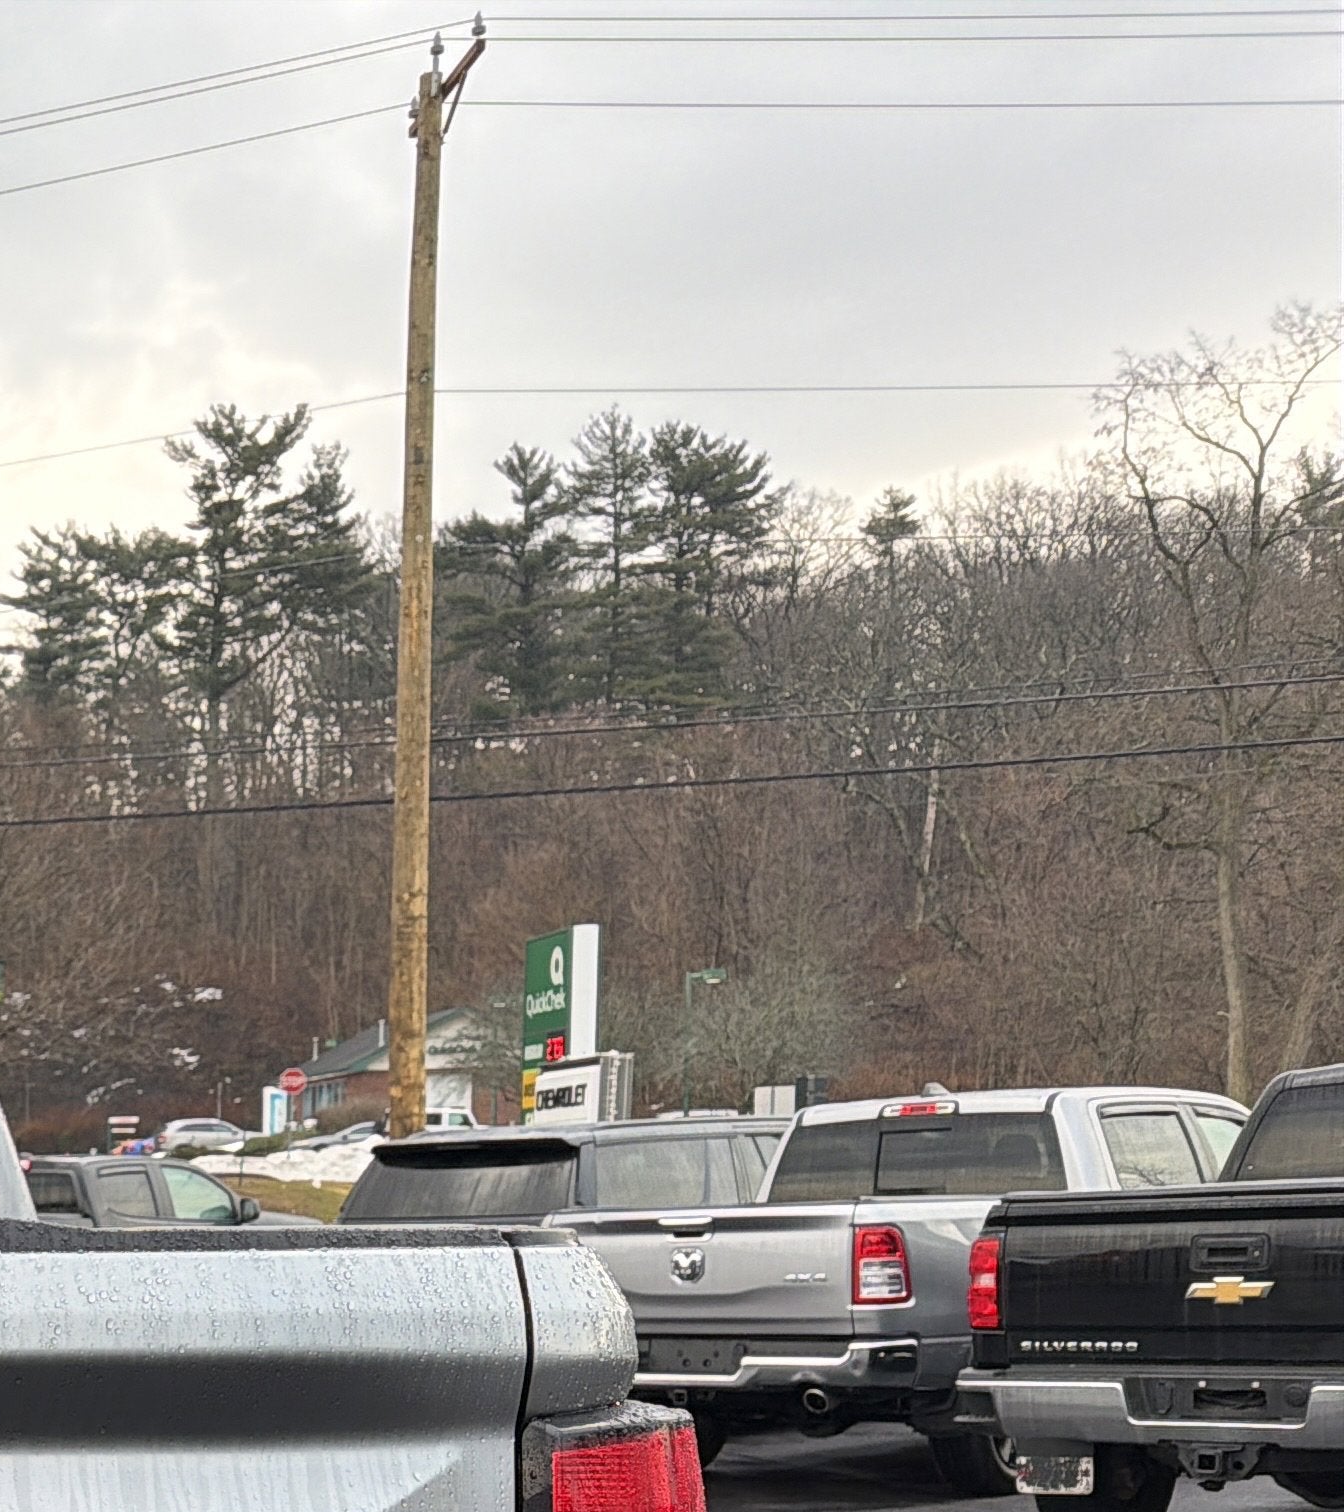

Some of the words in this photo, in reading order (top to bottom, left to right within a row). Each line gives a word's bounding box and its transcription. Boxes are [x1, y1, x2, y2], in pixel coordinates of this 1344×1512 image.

[525, 988, 566, 1019] QuickChek
[536, 1083, 587, 1111] CHEVROLET
[1020, 1341, 1139, 1352] SILVERADO
